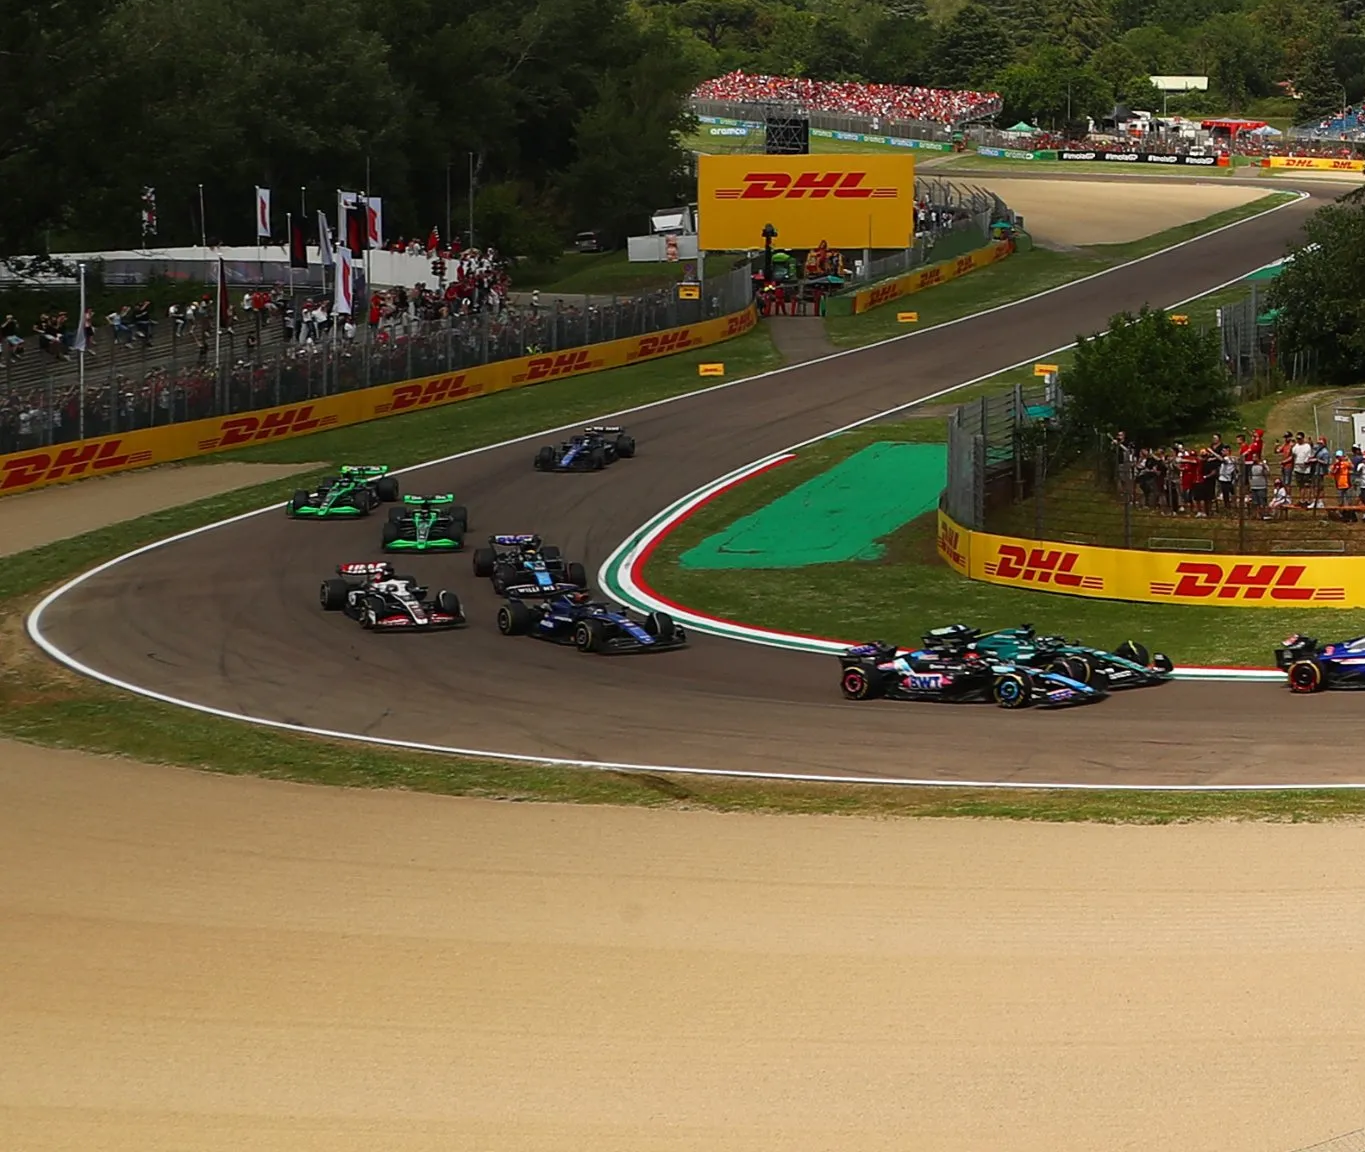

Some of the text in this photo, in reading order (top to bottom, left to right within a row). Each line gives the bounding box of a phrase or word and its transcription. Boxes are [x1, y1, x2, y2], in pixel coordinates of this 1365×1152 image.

[710, 127, 747, 136] aramco
[1285, 159, 1313, 167] DHL
[742, 172, 875, 198] DHL
[868, 284, 899, 307] DHL
[638, 330, 694, 357] DHL
[527, 350, 593, 379] DHL
[391, 375, 473, 411] DHL
[219, 406, 321, 447] DHL
[1, 440, 130, 489] DHL
[996, 544, 1084, 585] DHL
[1173, 562, 1316, 600] DHL
